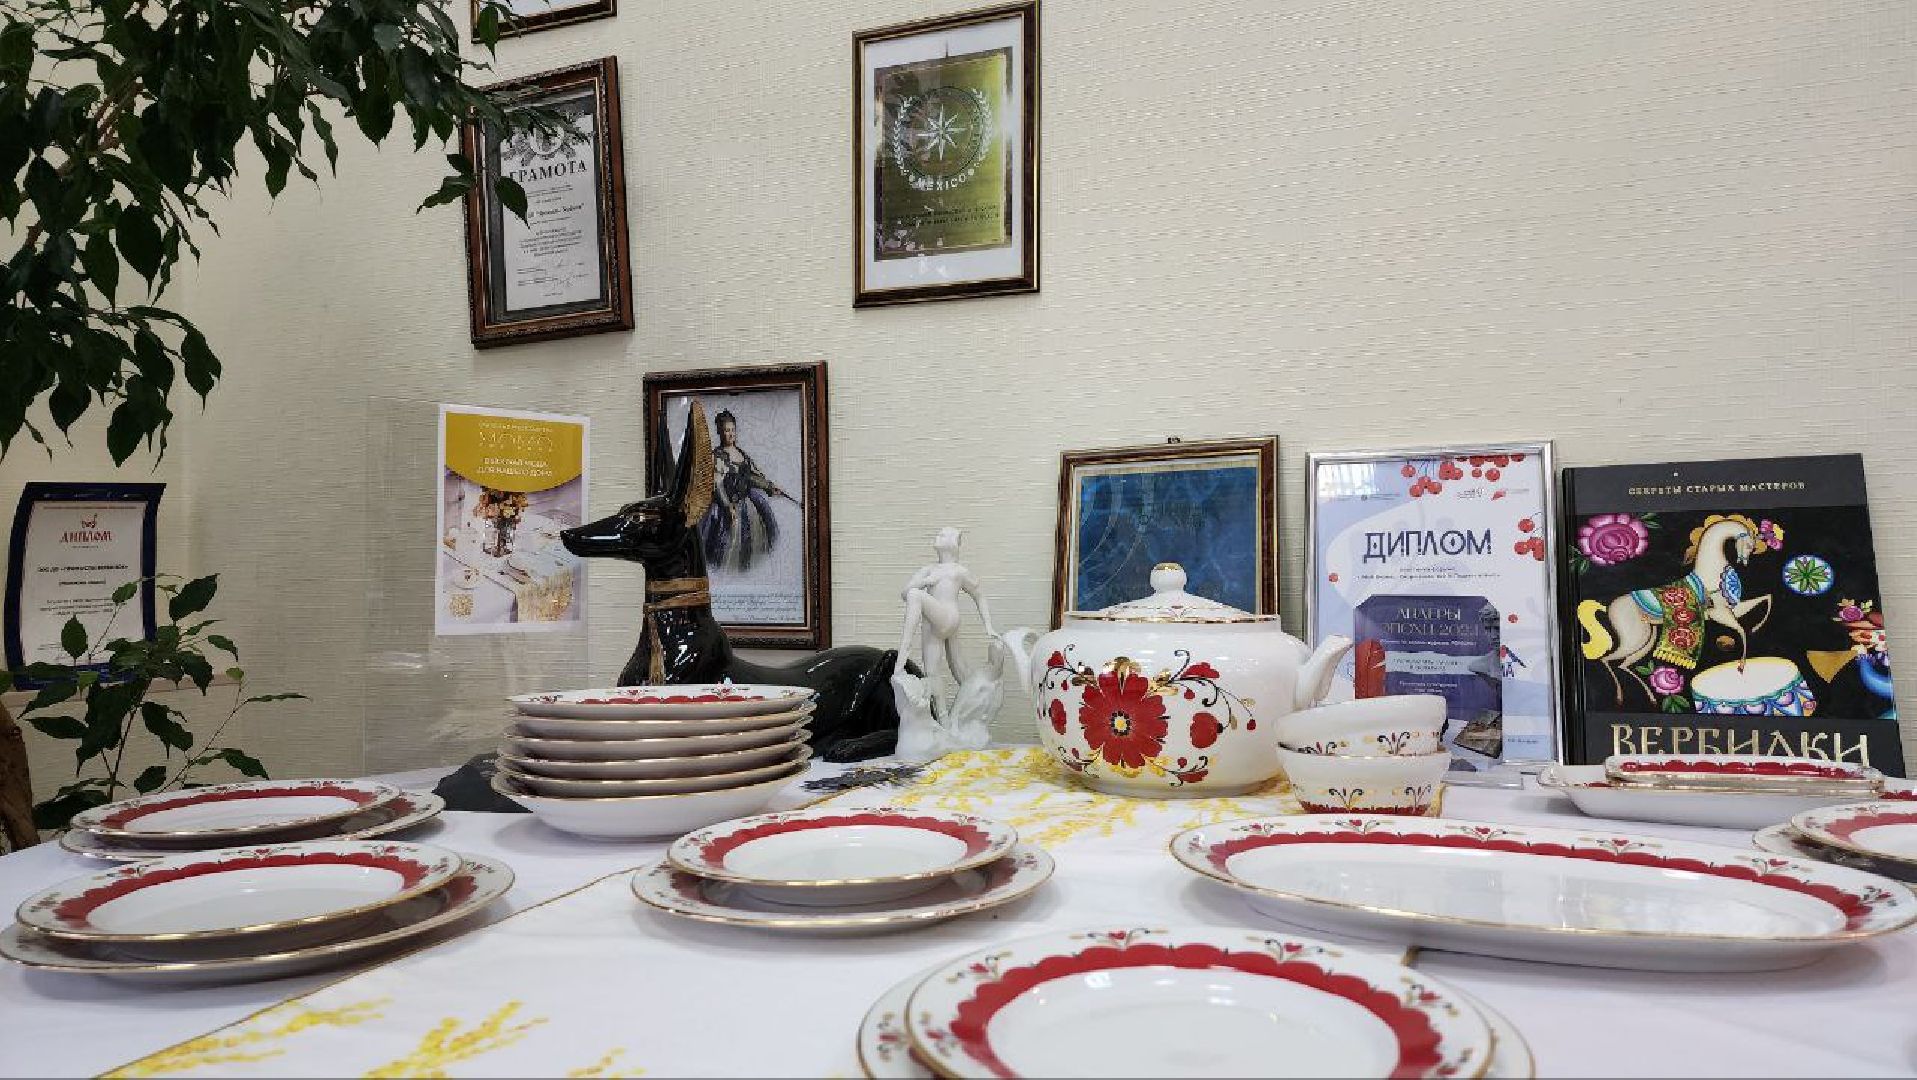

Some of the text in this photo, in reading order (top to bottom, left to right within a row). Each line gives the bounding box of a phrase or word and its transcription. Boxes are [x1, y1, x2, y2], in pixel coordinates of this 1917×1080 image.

[509, 159, 588, 183] ГРАМОТА
[1628, 481, 1806, 495] СЕКРЕТЫ СТАРЫХ МАСТЕРОВ
[59, 530, 113, 543] ДИПЛОМ
[1363, 528, 1492, 564] ДИПЛОМ
[1610, 723, 1870, 768] ВЕРБИЛКИ
